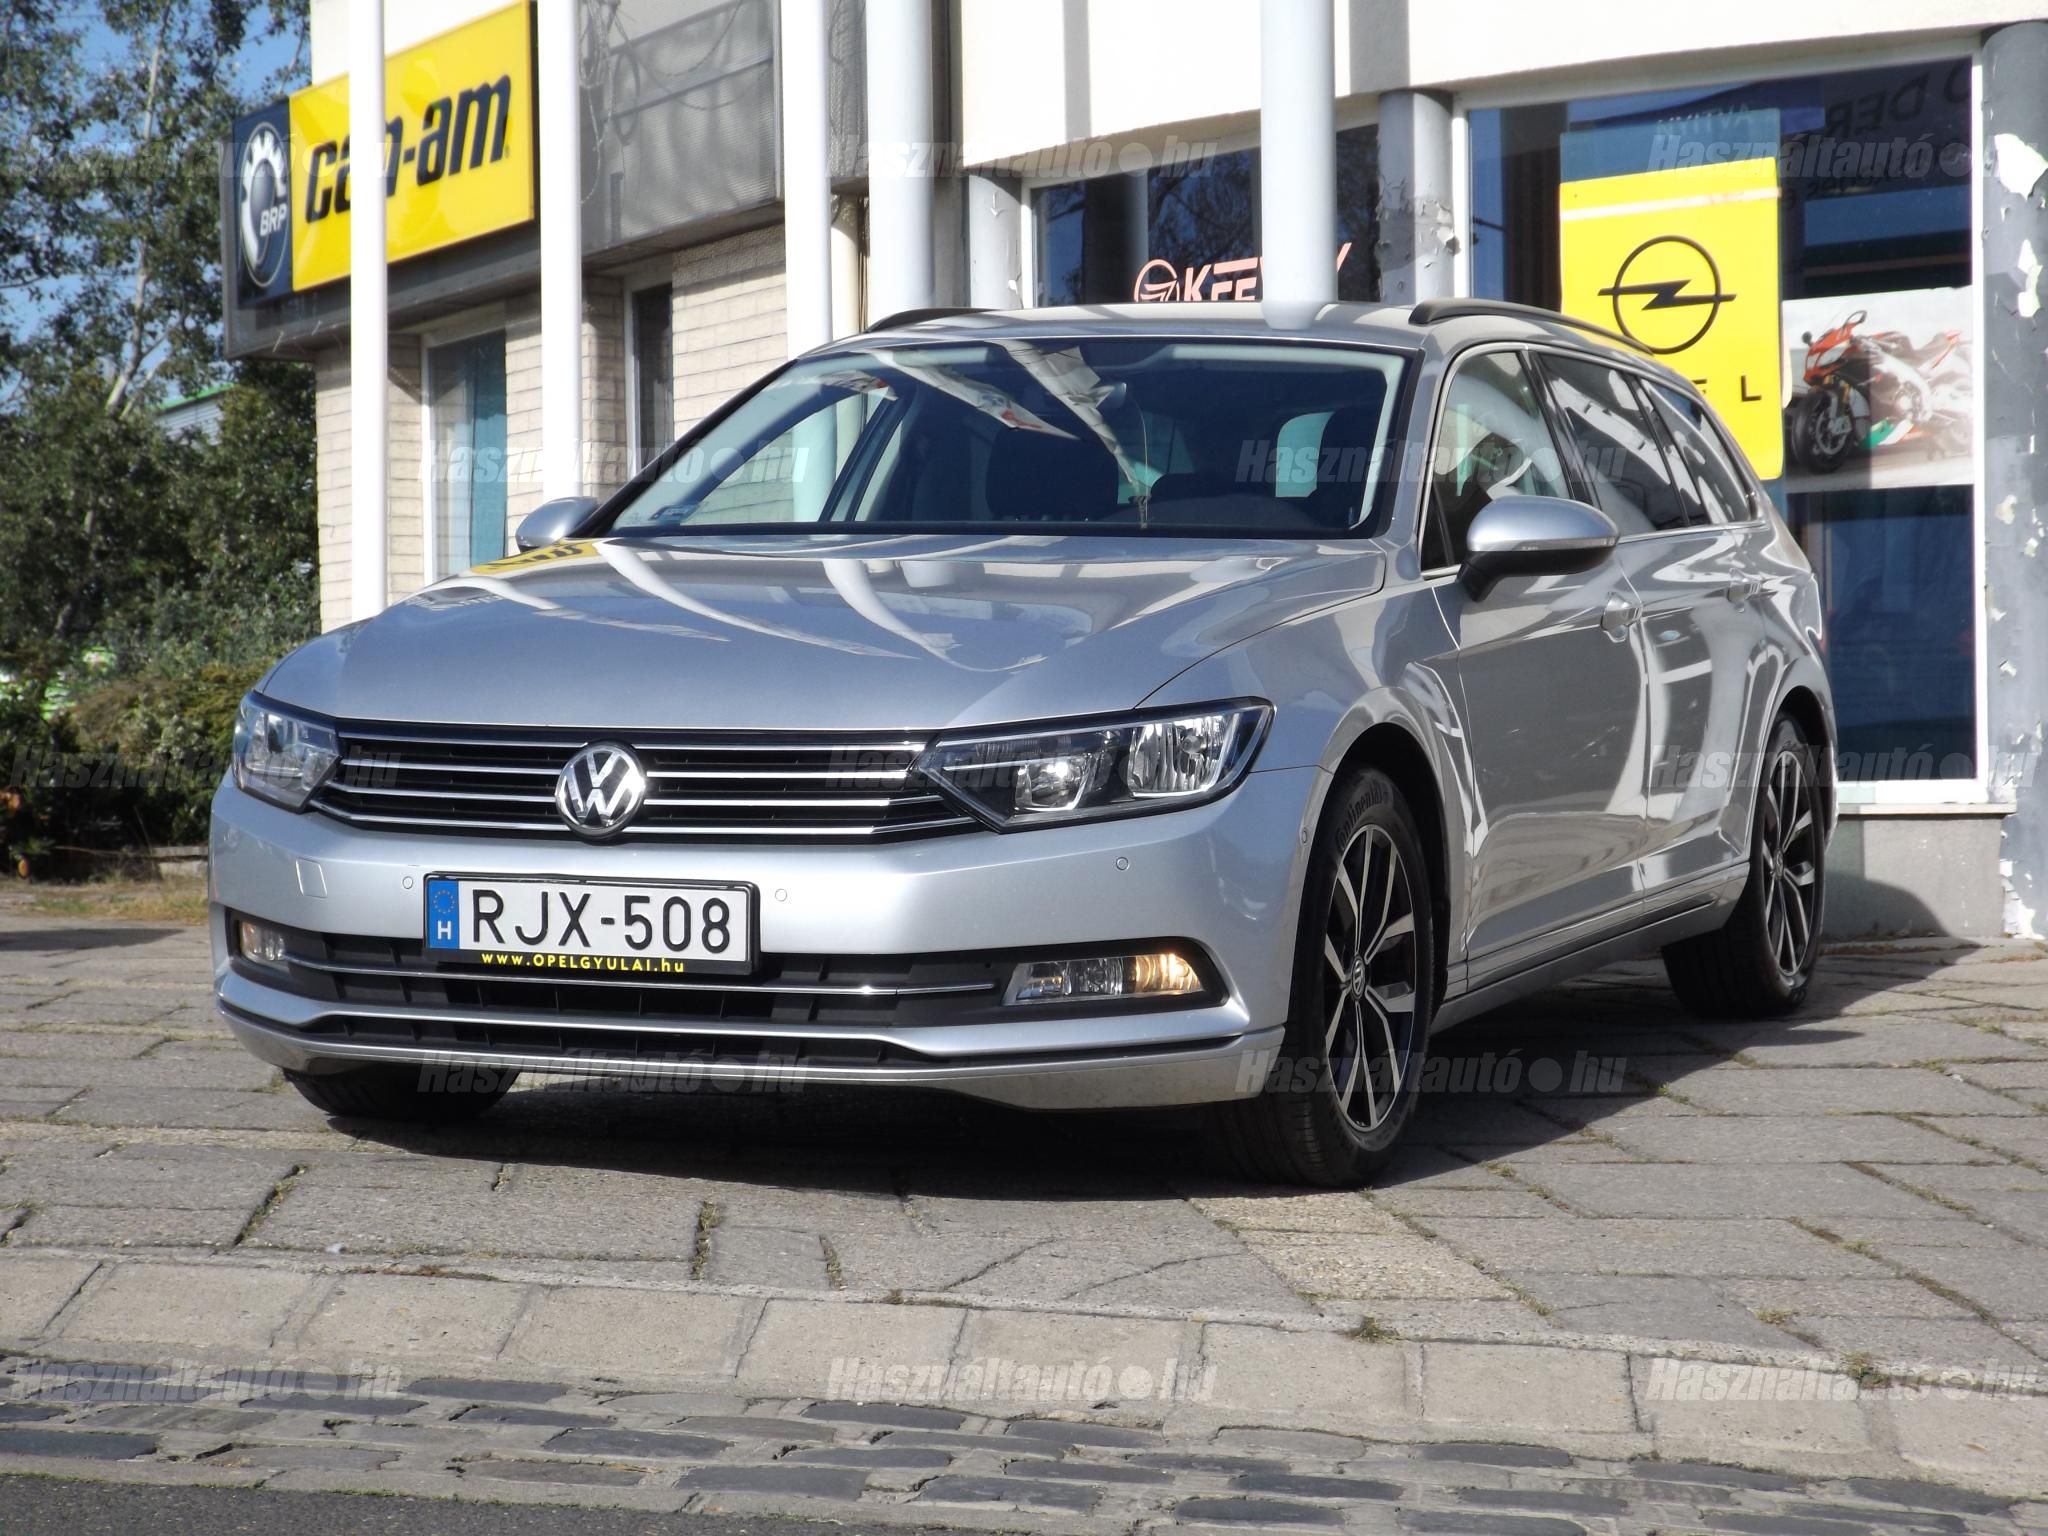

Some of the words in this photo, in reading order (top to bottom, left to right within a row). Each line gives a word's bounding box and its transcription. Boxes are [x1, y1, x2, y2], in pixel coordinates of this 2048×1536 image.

[260, 203, 288, 236] BRP
[437, 920, 452, 940] H
[472, 889, 731, 953] RJX-508
[481, 952, 685, 973] www.OPELGYULAI.hu
